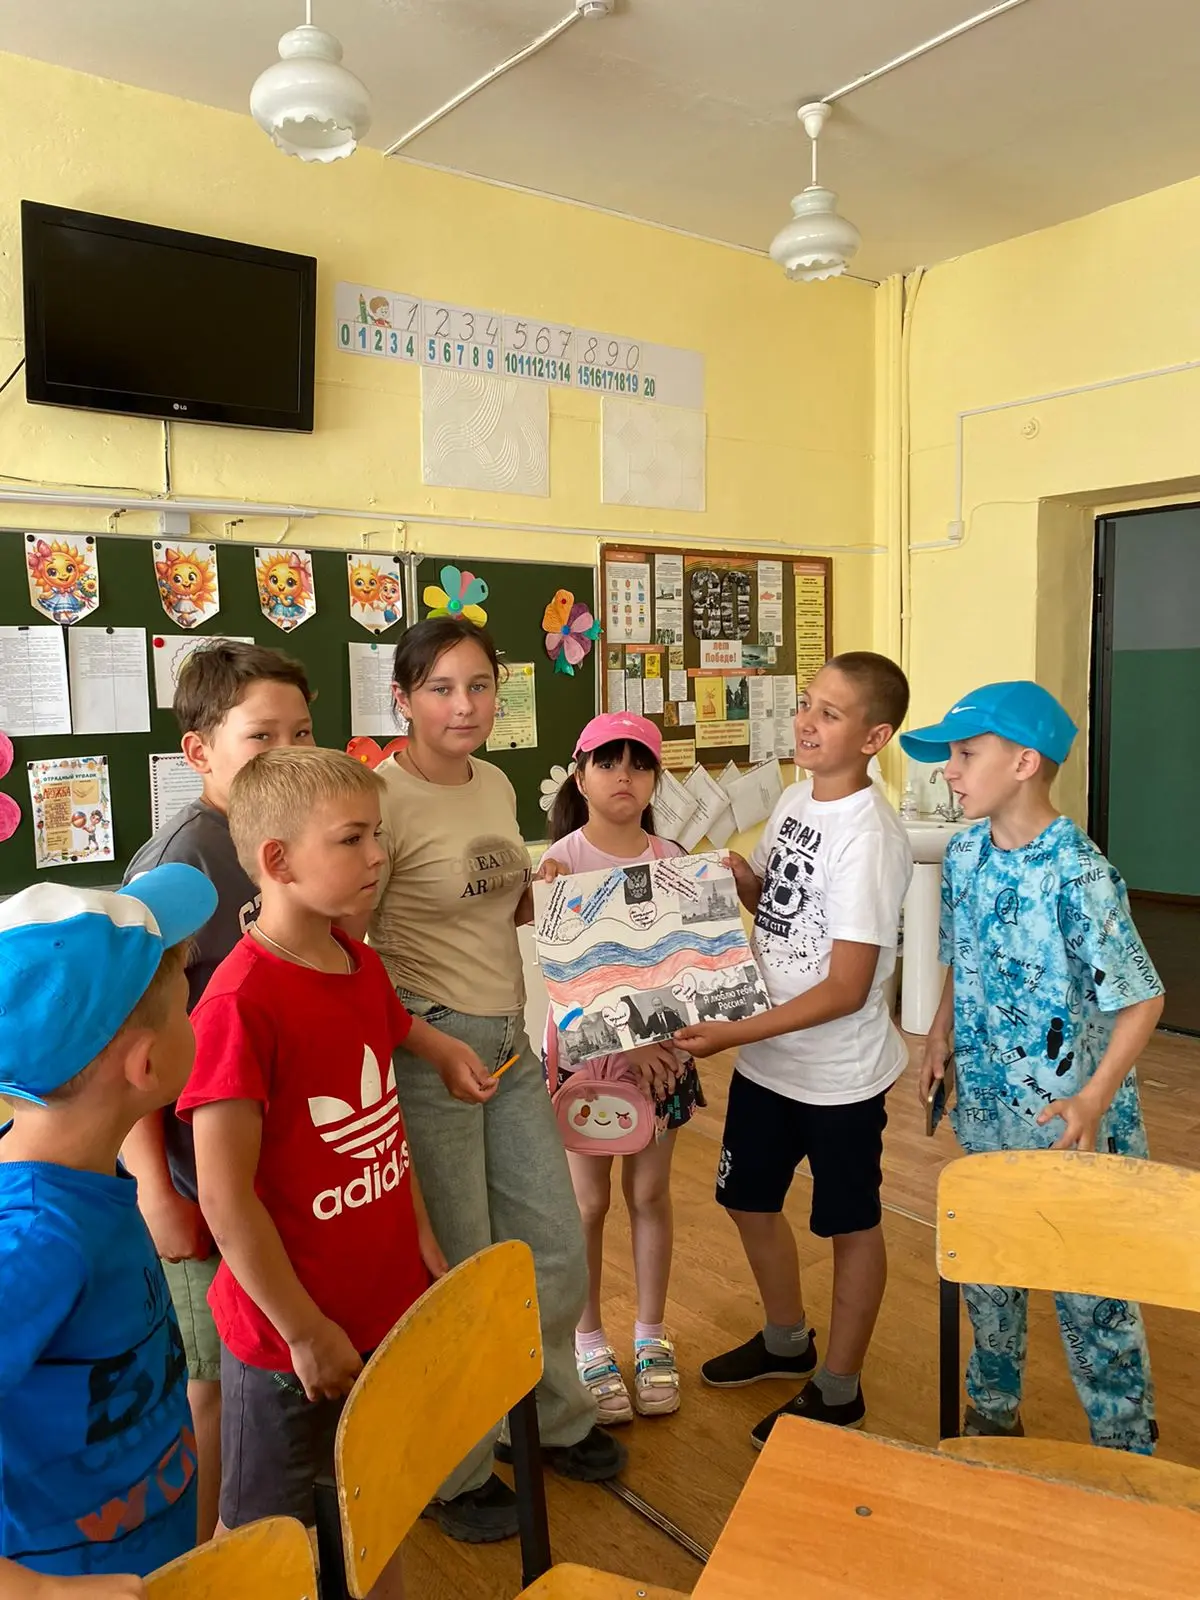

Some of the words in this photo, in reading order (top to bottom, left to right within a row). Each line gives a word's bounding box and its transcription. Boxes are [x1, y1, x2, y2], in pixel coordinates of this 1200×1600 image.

[407, 303, 419, 331] 1
[435, 308, 450, 337] 2
[459, 313, 474, 341] 3
[486, 317, 499, 345] 4
[512, 322, 527, 350] 5
[535, 327, 551, 355] 6
[559, 330, 572, 358] 7
[583, 337, 598, 364] 8
[605, 341, 619, 367] 9
[626, 345, 640, 371] 0
[341, 323, 350, 346] 0
[358, 326, 367, 349] 1
[374, 329, 383, 351] 2
[390, 332, 398, 354] 3
[406, 335, 414, 357] 4
[428, 338, 436, 361] 5
[443, 342, 451, 363] 6
[457, 344, 465, 366] 7
[472, 346, 480, 367] 8
[487, 348, 495, 370] 9
[505, 352, 518, 373] 10
[518, 354, 532, 377] 11
[532, 356, 544, 378] 12
[545, 359, 557, 380] 13
[559, 361, 571, 382] 14
[578, 364, 590, 386] 15
[589, 366, 602, 388] 16
[602, 369, 614, 390] 17
[614, 370, 626, 391] 18
[626, 372, 639, 393] 19
[643, 377, 656, 397] 20
[705, 652, 737, 663] Победе!
[703, 995, 710, 1004] Я
[711, 990, 736, 1003] люблю
[718, 996, 747, 1010] Россия!
[1022, 1074, 1056, 1104] TREN
